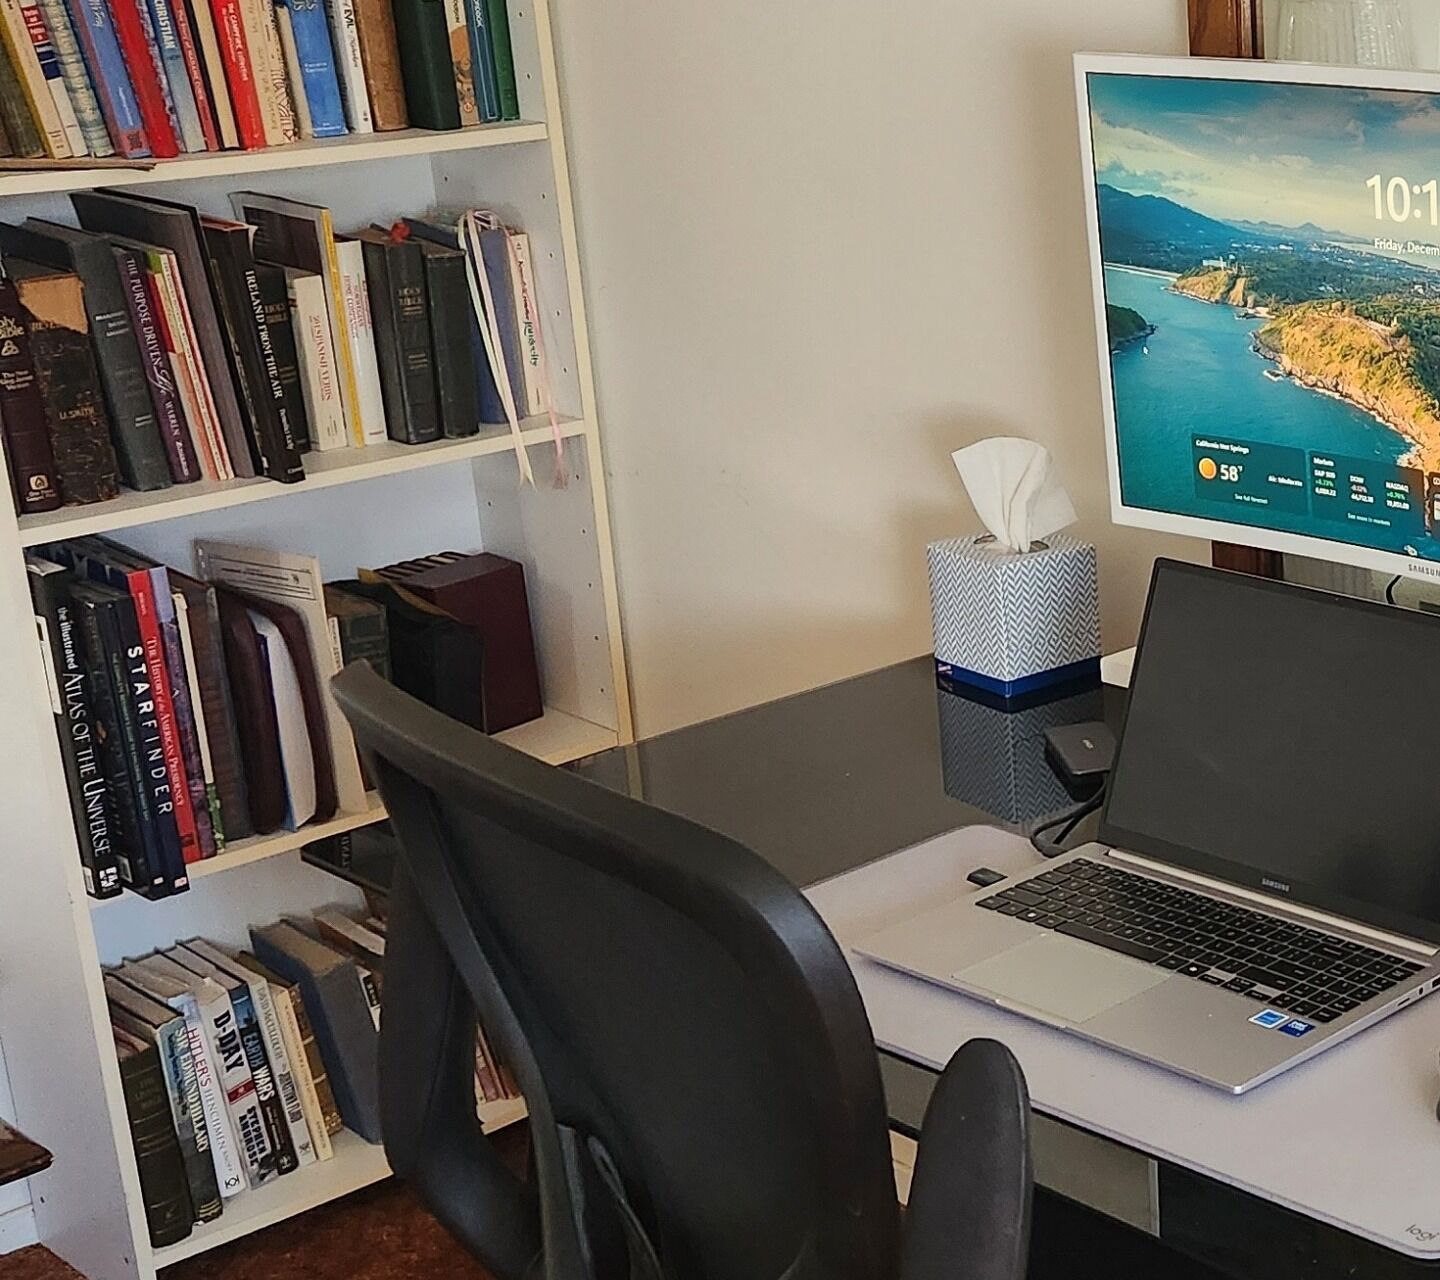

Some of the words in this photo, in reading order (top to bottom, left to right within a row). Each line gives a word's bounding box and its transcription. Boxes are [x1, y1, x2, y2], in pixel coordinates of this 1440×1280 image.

[344, 8, 353, 28] EVIL
[1374, 238, 1406, 254] Friday,
[126, 257, 136, 275] THE
[130, 276, 151, 324] PURPOSE
[243, 269, 266, 323] IRELAND
[143, 325, 162, 367] DRIVEN
[257, 324, 273, 354] FROM
[264, 354, 277, 378] THE
[269, 377, 282, 399] AIR
[162, 400, 182, 437] WARREN
[57, 606, 68, 621] the
[60, 621, 78, 669] illustrated
[146, 638, 157, 657] THE
[64, 669, 90, 719] ATLAS
[150, 659, 164, 695] HISTORY
[72, 721, 90, 744] OF
[127, 644, 171, 815] STARFINDER
[160, 713, 176, 756] AMERICAN
[77, 746, 95, 777] THE
[168, 757, 186, 807] PRESIDENCY
[83, 778, 113, 857] UNIVERSE
[1261, 877, 1290, 893] SAMSUNG
[173, 1027, 189, 1051] SIR
[212, 1010, 246, 1073] D-DAY
[241, 1031, 265, 1067] EARTH
[177, 1052, 202, 1105] EDMUND
[186, 1027, 212, 1087] HITLER'S
[202, 1087, 228, 1150] HENCHMEN
[250, 1065, 277, 1102] WARS
[187, 1102, 211, 1153] HILLARY
[247, 1105, 267, 1158] STEPHEN
[1405, 1224, 1440, 1241] logi
